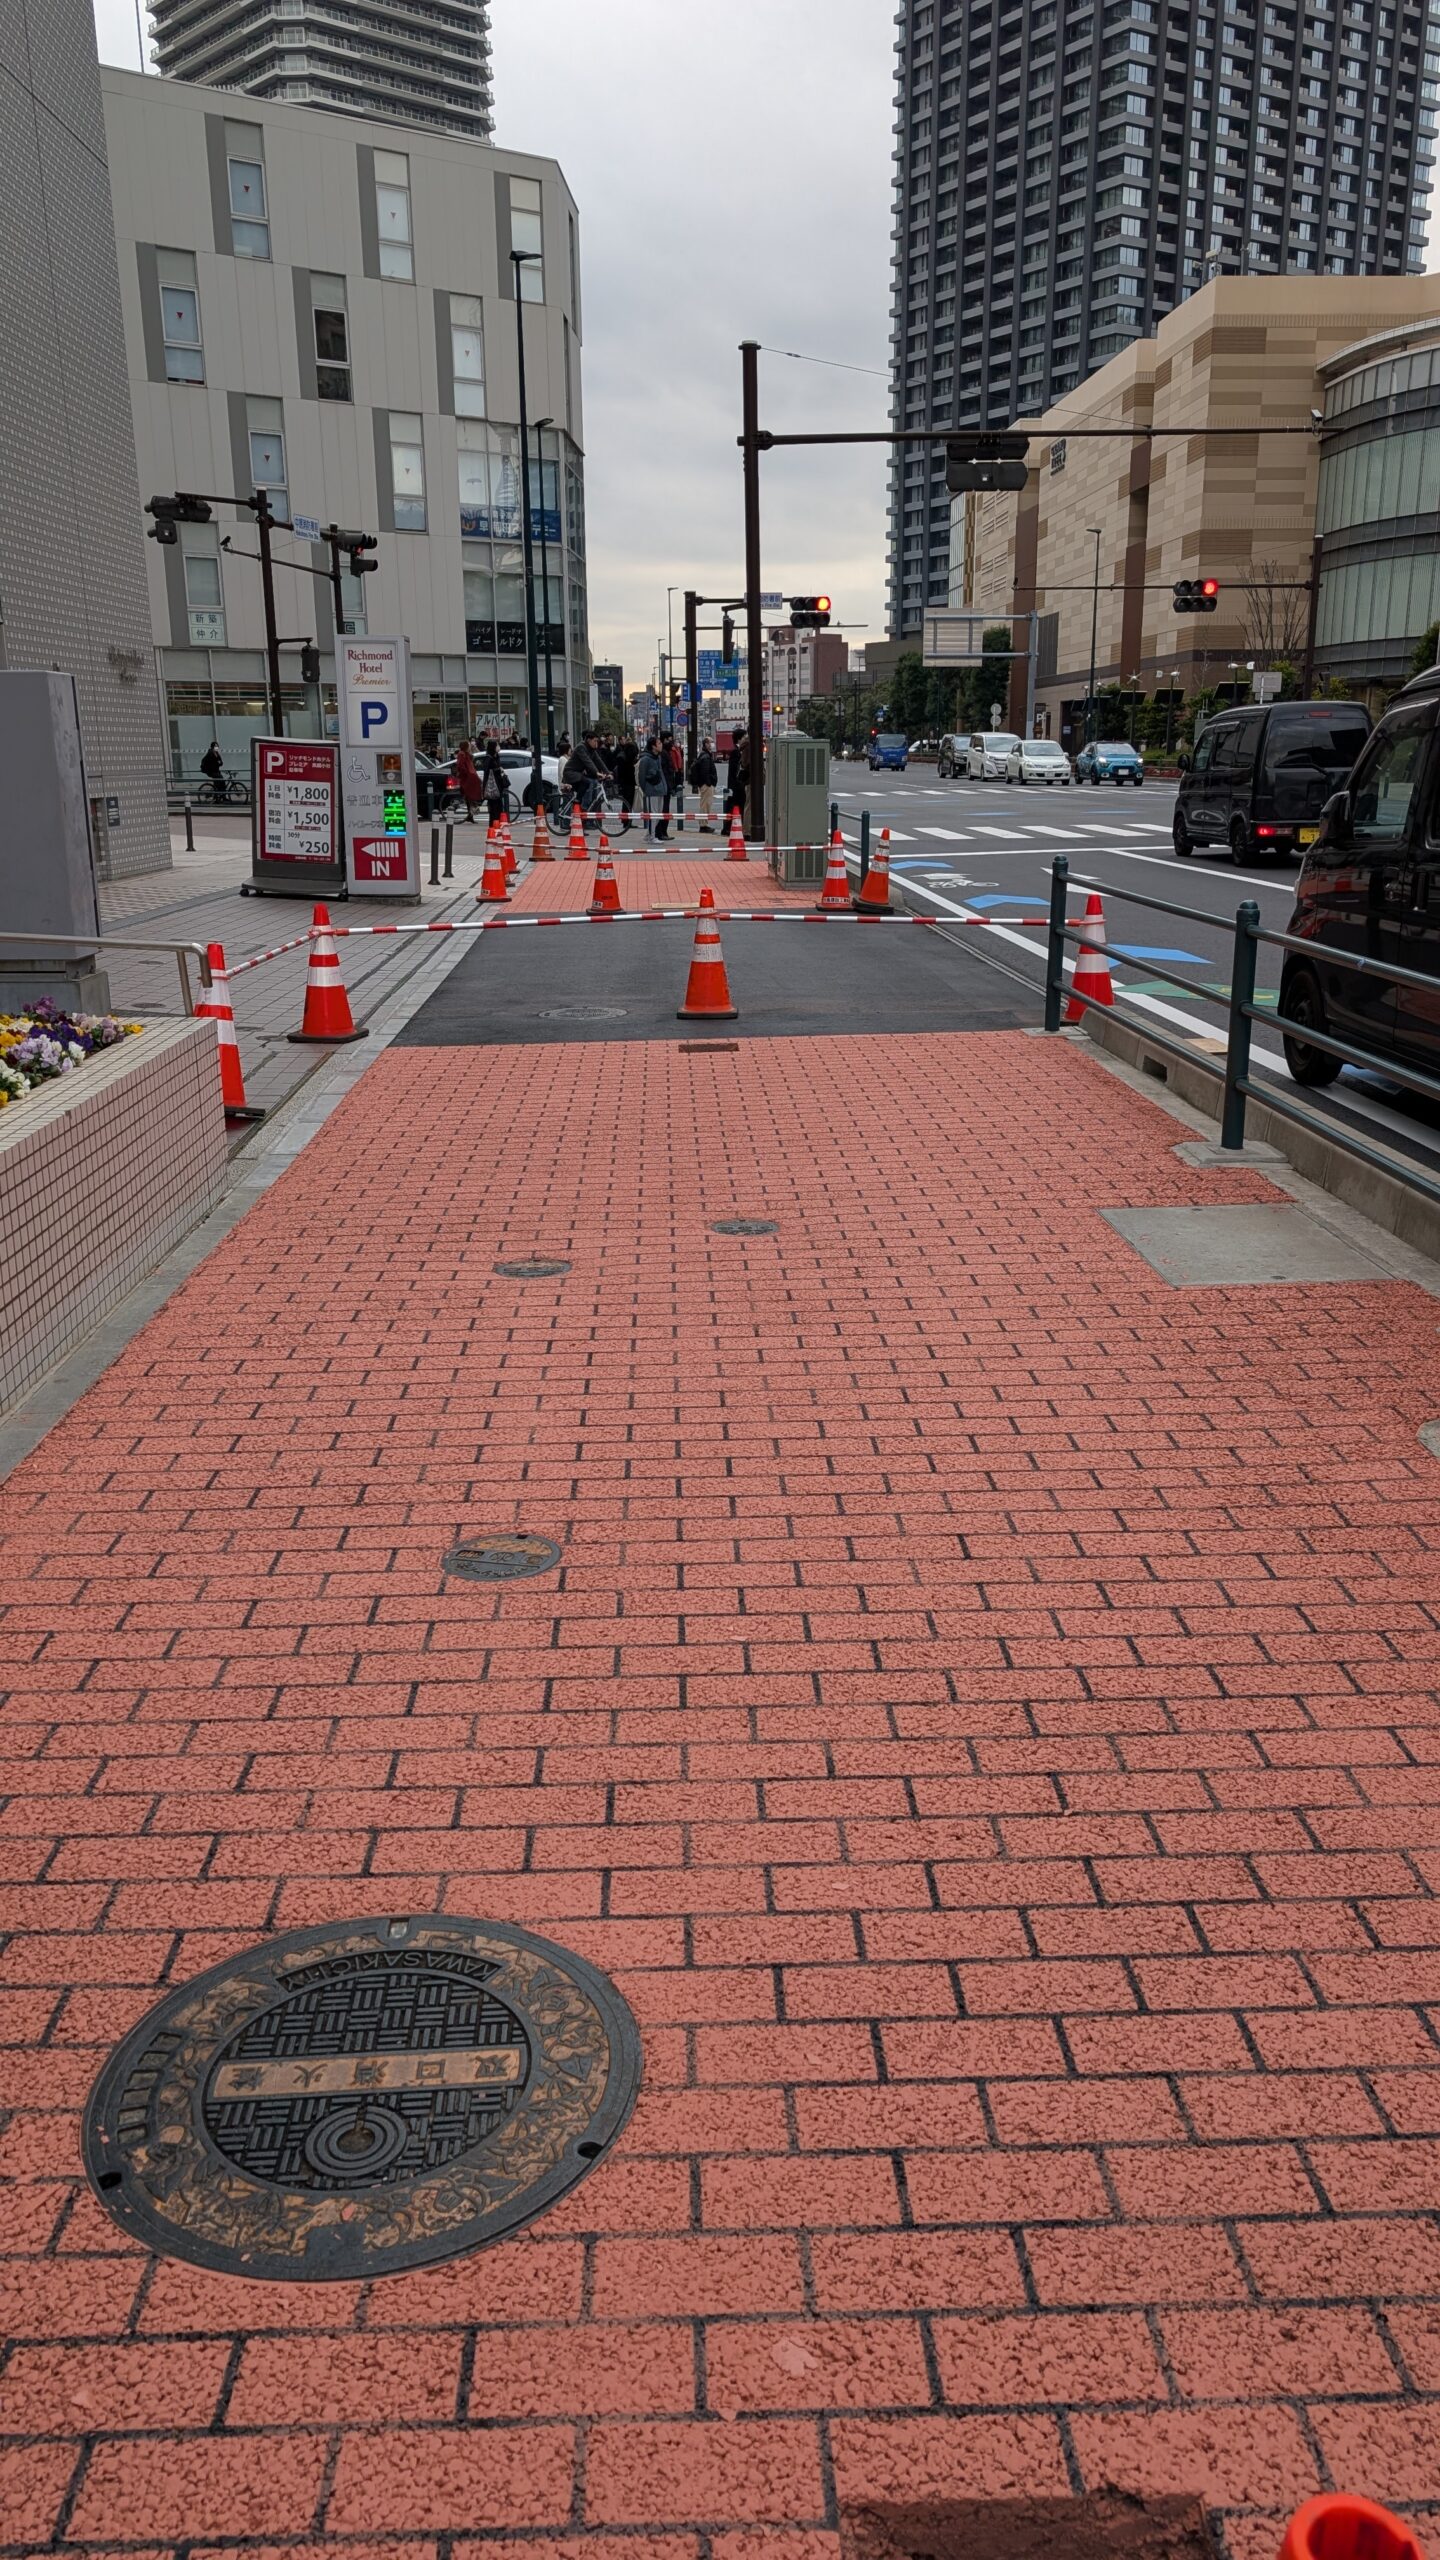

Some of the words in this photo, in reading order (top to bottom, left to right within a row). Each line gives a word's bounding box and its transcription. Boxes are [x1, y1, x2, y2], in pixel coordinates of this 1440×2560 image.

[196, 628, 218, 639] 仲介
[347, 649, 393, 661] Richmond
[359, 662, 383, 673] Hotel
[352, 674, 392, 686] Premier
[361, 701, 388, 738] P
[476, 714, 515, 727] アルバイト
[266, 752, 284, 773] P
[287, 785, 329, 801] ¥1,800
[287, 811, 329, 826] ¥1,500
[299, 841, 329, 854] ¥250
[371, 861, 390, 876] IN
[228, 2053, 511, 2092] 双口消火栓
